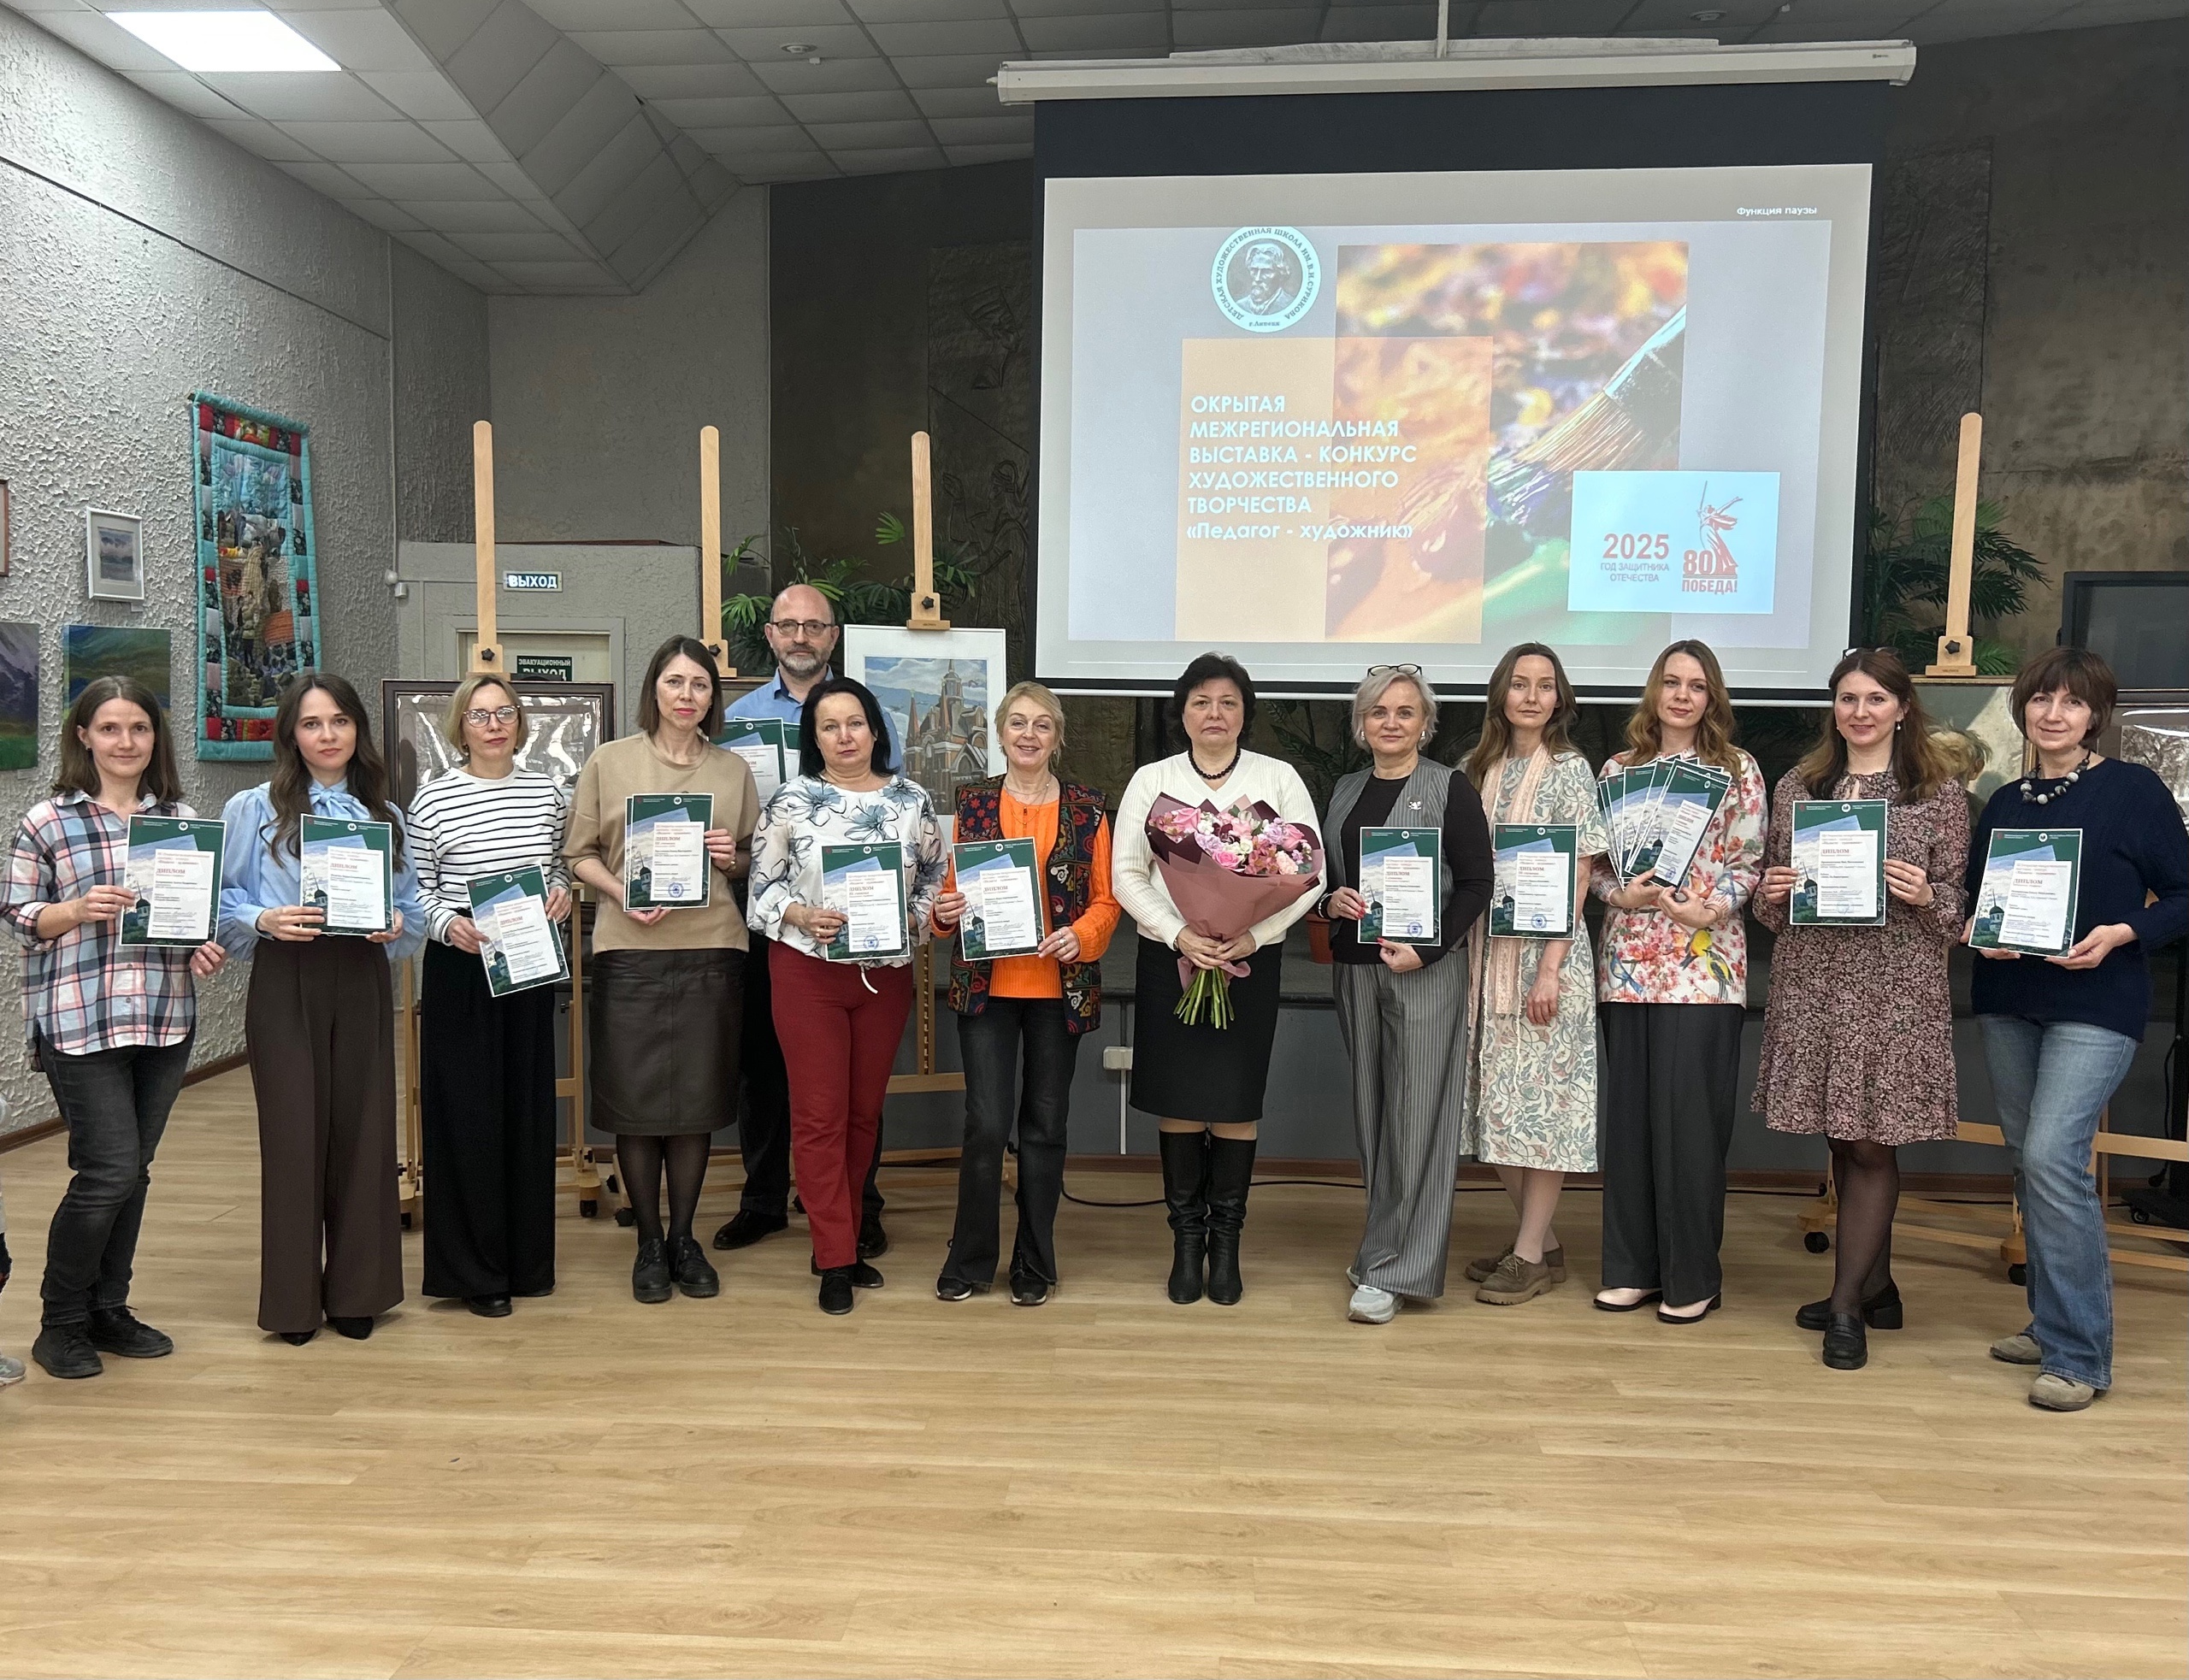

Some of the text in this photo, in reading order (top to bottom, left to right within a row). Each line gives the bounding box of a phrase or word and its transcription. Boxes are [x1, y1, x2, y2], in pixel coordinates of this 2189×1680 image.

[1737, 207, 1817, 216] Функция паузы
[1274, 228, 1302, 249] ШКОЛА
[1216, 227, 1272, 284] ХУДОЖЕСТВЕННАЯ
[1217, 286, 1244, 321] ДЕТСКАЯ
[1190, 396, 1285, 413] ОКРЫТАЯ
[1189, 420, 1398, 438] МЕЖРЕГИОНАЛЬНАЯ
[1189, 445, 1298, 463] ВЫСТАВКА
[1319, 445, 1417, 463] КОНКУРС
[1188, 470, 1399, 490] ХУДОЖЕСТВЕННОГО
[1187, 496, 1312, 514] ТВОРЧЕСТВА
[1186, 522, 1280, 540] «Педагог
[1300, 524, 1413, 542] художник»
[1602, 533, 1669, 559] 2025
[1601, 562, 1669, 572] ГОД ЗАЩИТНИКА
[1683, 549, 1714, 575] 80
[508, 575, 558, 589] ВЫХОД
[1609, 573, 1660, 582] ОТЕЧЕСТВА
[1681, 579, 1738, 595] ПОБЕДА!
